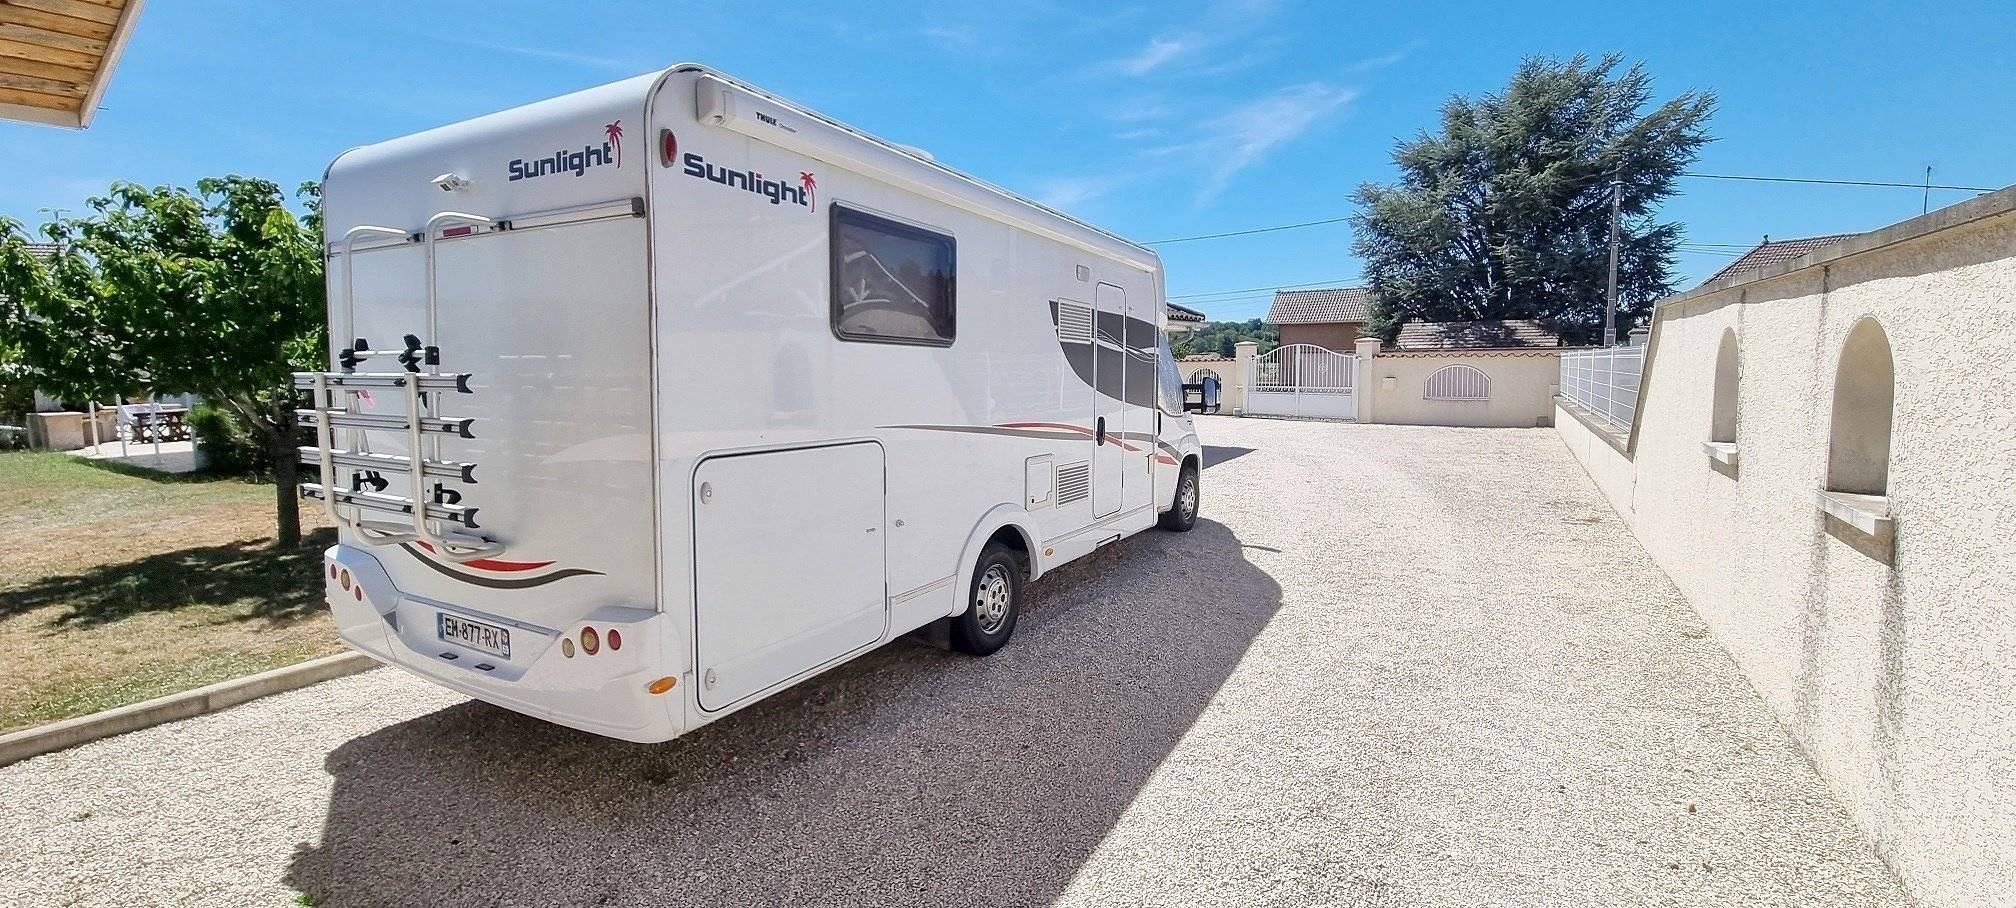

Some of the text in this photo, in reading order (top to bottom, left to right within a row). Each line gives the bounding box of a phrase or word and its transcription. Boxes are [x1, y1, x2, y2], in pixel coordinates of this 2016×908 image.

[756, 112, 777, 126] THULE
[508, 141, 613, 182] Sunlight
[683, 152, 808, 207] Sunlight
